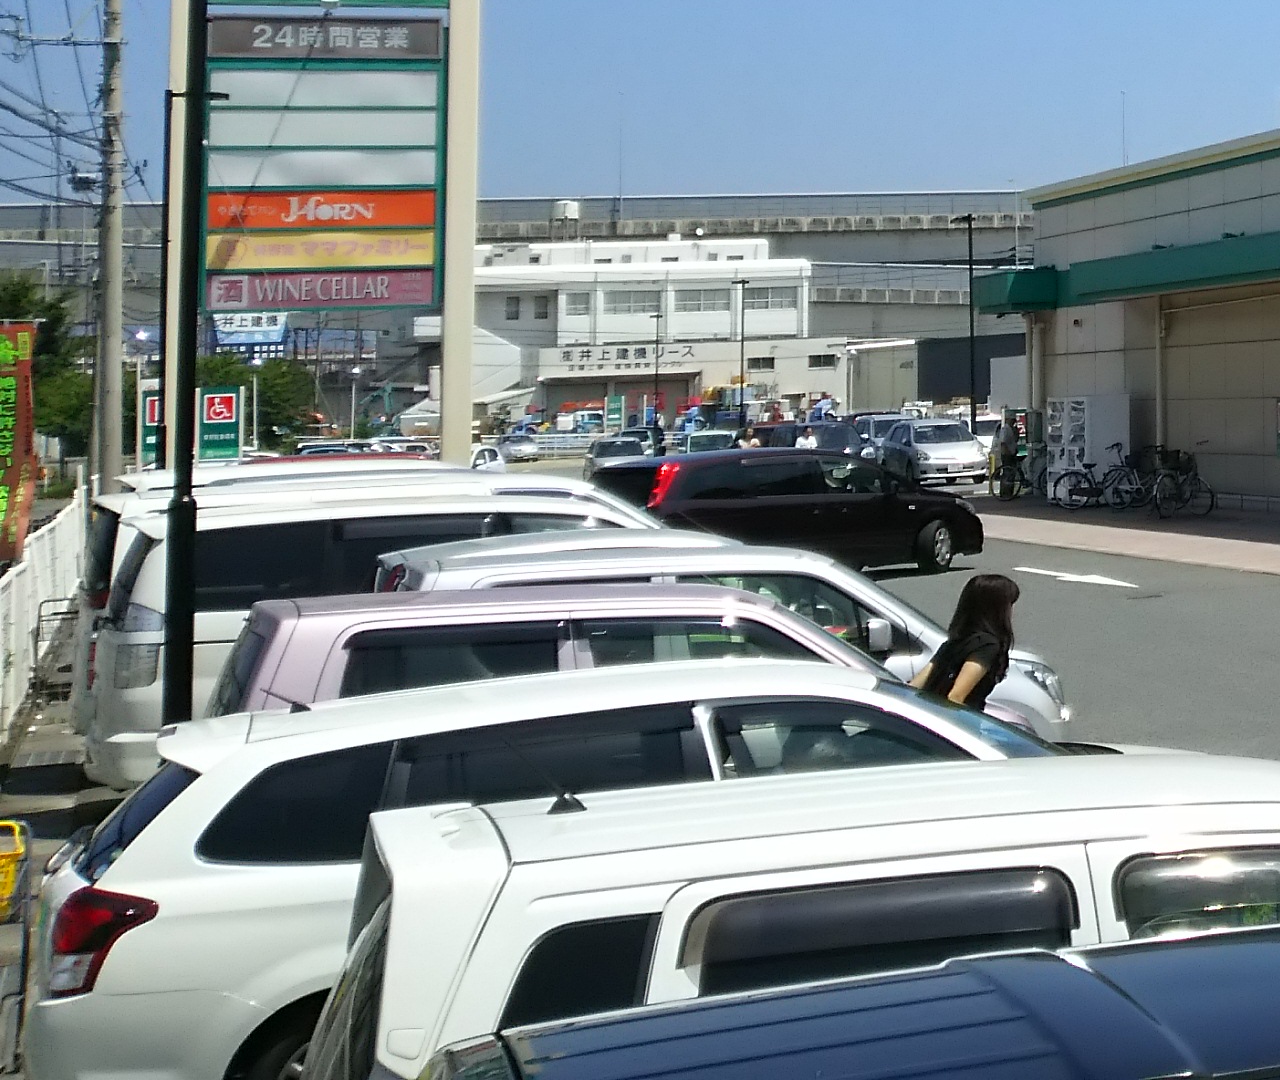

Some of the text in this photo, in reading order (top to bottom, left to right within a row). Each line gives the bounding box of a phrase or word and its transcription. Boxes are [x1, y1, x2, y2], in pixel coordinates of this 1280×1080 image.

[252, 24, 409, 49] 24時間営業
[215, 277, 244, 304] 酒
[255, 276, 313, 303] WINE
[317, 275, 390, 301] CELLAR
